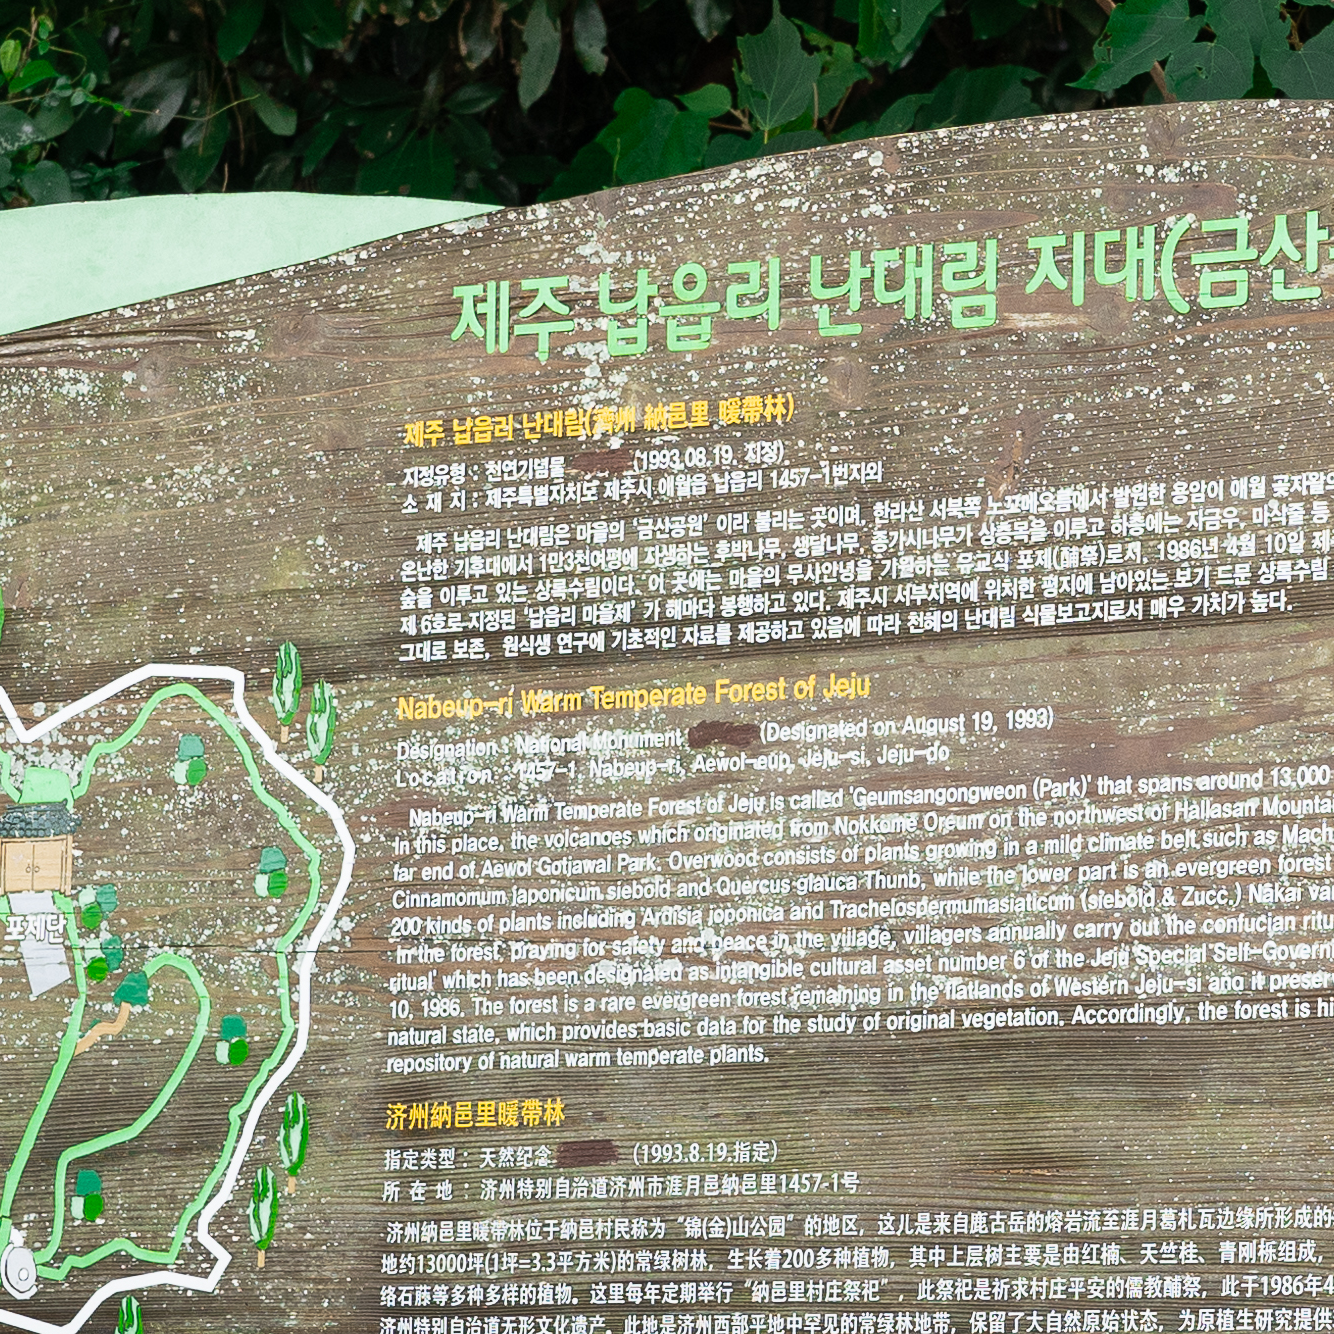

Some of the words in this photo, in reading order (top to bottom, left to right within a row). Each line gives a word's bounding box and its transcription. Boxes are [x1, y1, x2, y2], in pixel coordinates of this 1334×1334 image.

[451, 273, 575, 364] 제주
[598, 257, 780, 357] 납읍리
[809, 239, 997, 337] 난대림
[403, 420, 445, 448] 제주
[452, 414, 514, 445] 납읍리
[403, 464, 465, 488] 지정유형
[485, 456, 565, 483] 천연기념물
[744, 439, 785, 465] 지정)
[485, 480, 599, 508] 제주특별자치도
[603, 478, 652, 502] 제주시
[658, 474, 707, 498] 애월읍
[714, 471, 764, 495] 납읍리
[416, 531, 448, 555] 제주
[453, 527, 501, 552] 납읍리
[506, 524, 570, 548] 난대림은
[575, 520, 625, 544] 마을의
[716, 512, 749, 535] 이라
[756, 508, 806, 533] 불리는
[873, 500, 925, 525] 한라산
[929, 496, 982, 521] 서북쪽
[1171, 478, 1224, 505] 용암이
[1229, 475, 1266, 501] 애월
[398, 639, 448, 663] 그대로
[452, 637, 490, 661] 보존,
[502, 634, 551, 658] 원식생
[556, 630, 605, 654] 연구에
[611, 626, 677, 651] 기초적인
[682, 622, 733, 647] 자료를
[738, 617, 805, 644] 제공하고
[811, 614, 861, 639] 있음에
[867, 612, 901, 635] 따라
[907, 608, 958, 633] 천혜의
[964, 604, 1016, 630] 난대림
[1022, 598, 1144, 627] 식물보고지로서
[1150, 594, 1185, 619] 매우
[1191, 591, 1246, 617] 가치가
[1251, 588, 1294, 614] 높다.
[398, 692, 514, 720] Nabeup-ri
[521, 689, 582, 714] Warm
[590, 683, 707, 711] Temperate
[715, 676, 786, 704] Forest
[793, 675, 815, 699] of
[823, 671, 870, 700] Jeju
[873, 720, 896, 737] on
[902, 713, 965, 737] August
[972, 710, 998, 734] 19,
[1005, 706, 1054, 730] 1993)
[4, 914, 67, 943] 포제단
[807, 1012, 857, 1036] study
[863, 1010, 881, 1030] of
[886, 1008, 955, 1033] original
[961, 1006, 1065, 1032] vegetation.
[1233, 998, 1288, 1019] forest
[387, 1052, 472, 1075] repository
[478, 1050, 496, 1070] of
[500, 1048, 559, 1069] natural
[564, 1051, 611, 1068] warm
[617, 1045, 704, 1068] temperate
[709, 1043, 770, 1065] plants.
